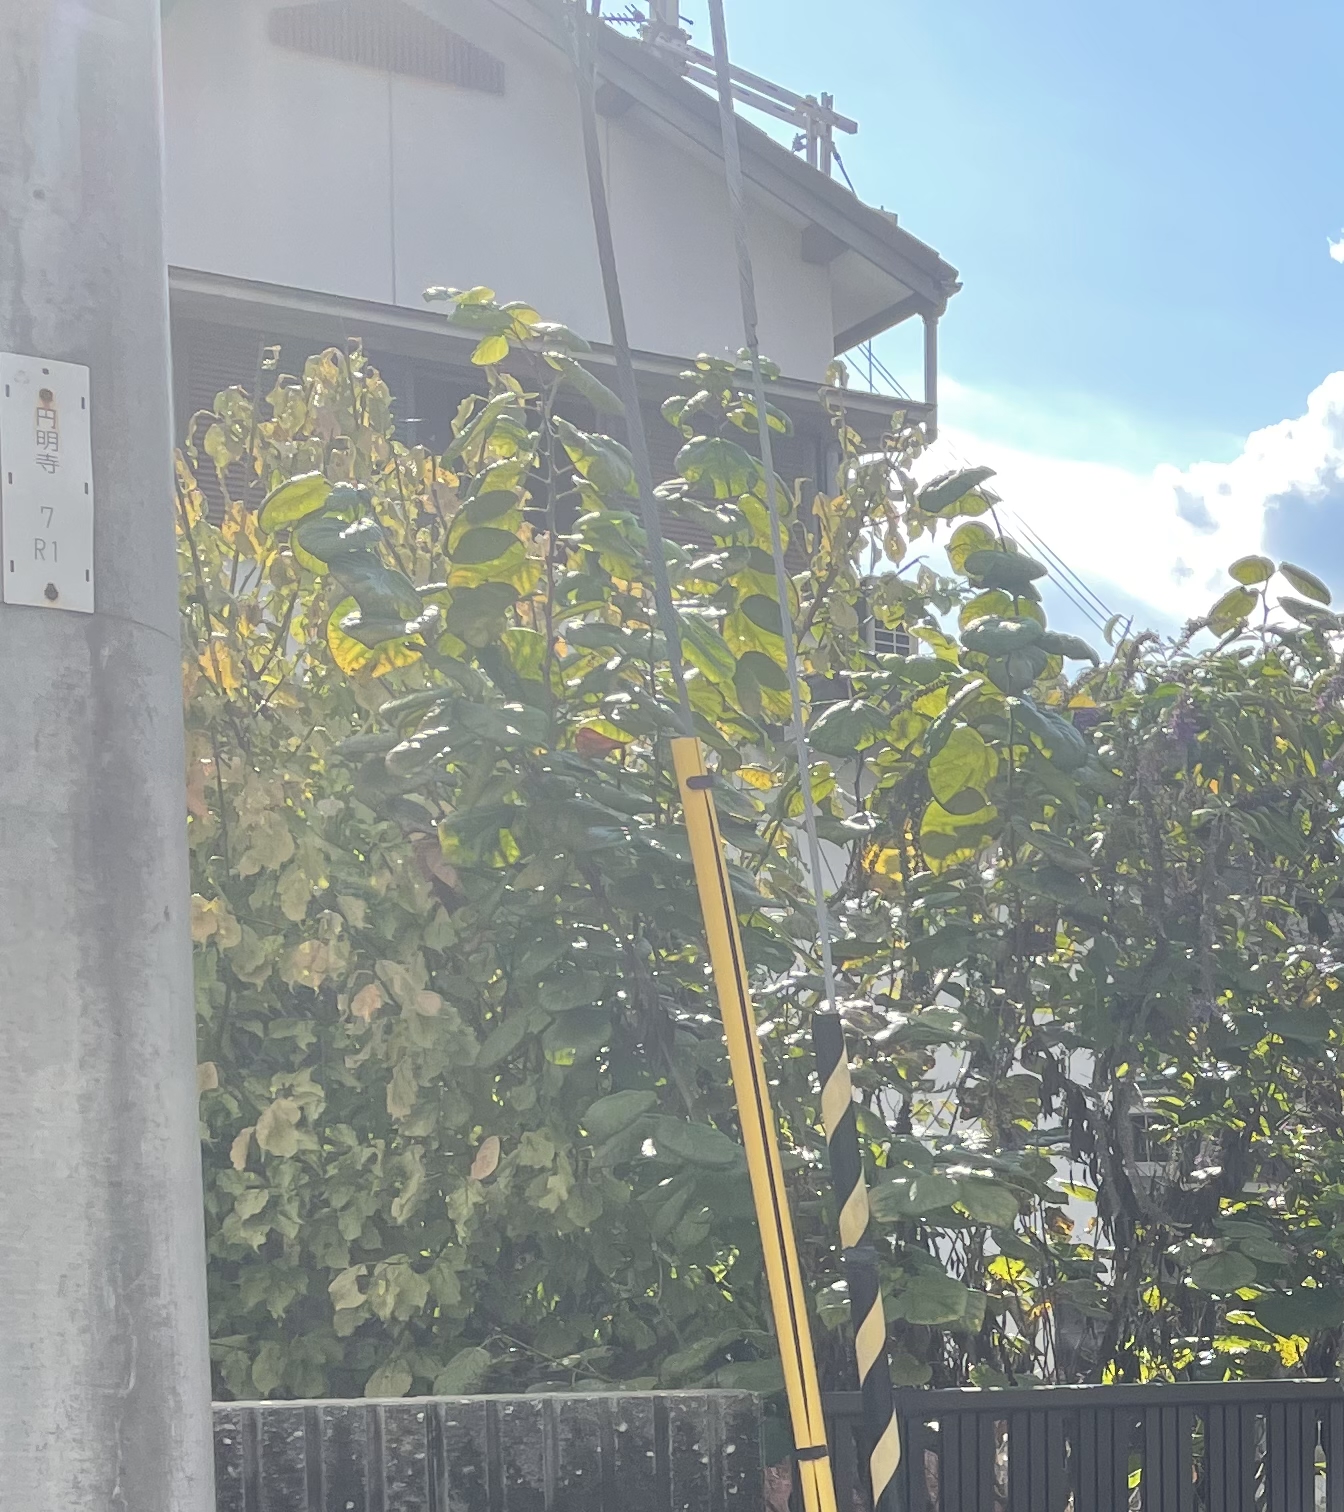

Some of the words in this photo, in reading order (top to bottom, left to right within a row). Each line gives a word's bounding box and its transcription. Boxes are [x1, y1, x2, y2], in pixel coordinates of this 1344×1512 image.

[35, 406, 60, 475] 円明寺
[40, 505, 54, 529] 7
[34, 537, 58, 563] R1
